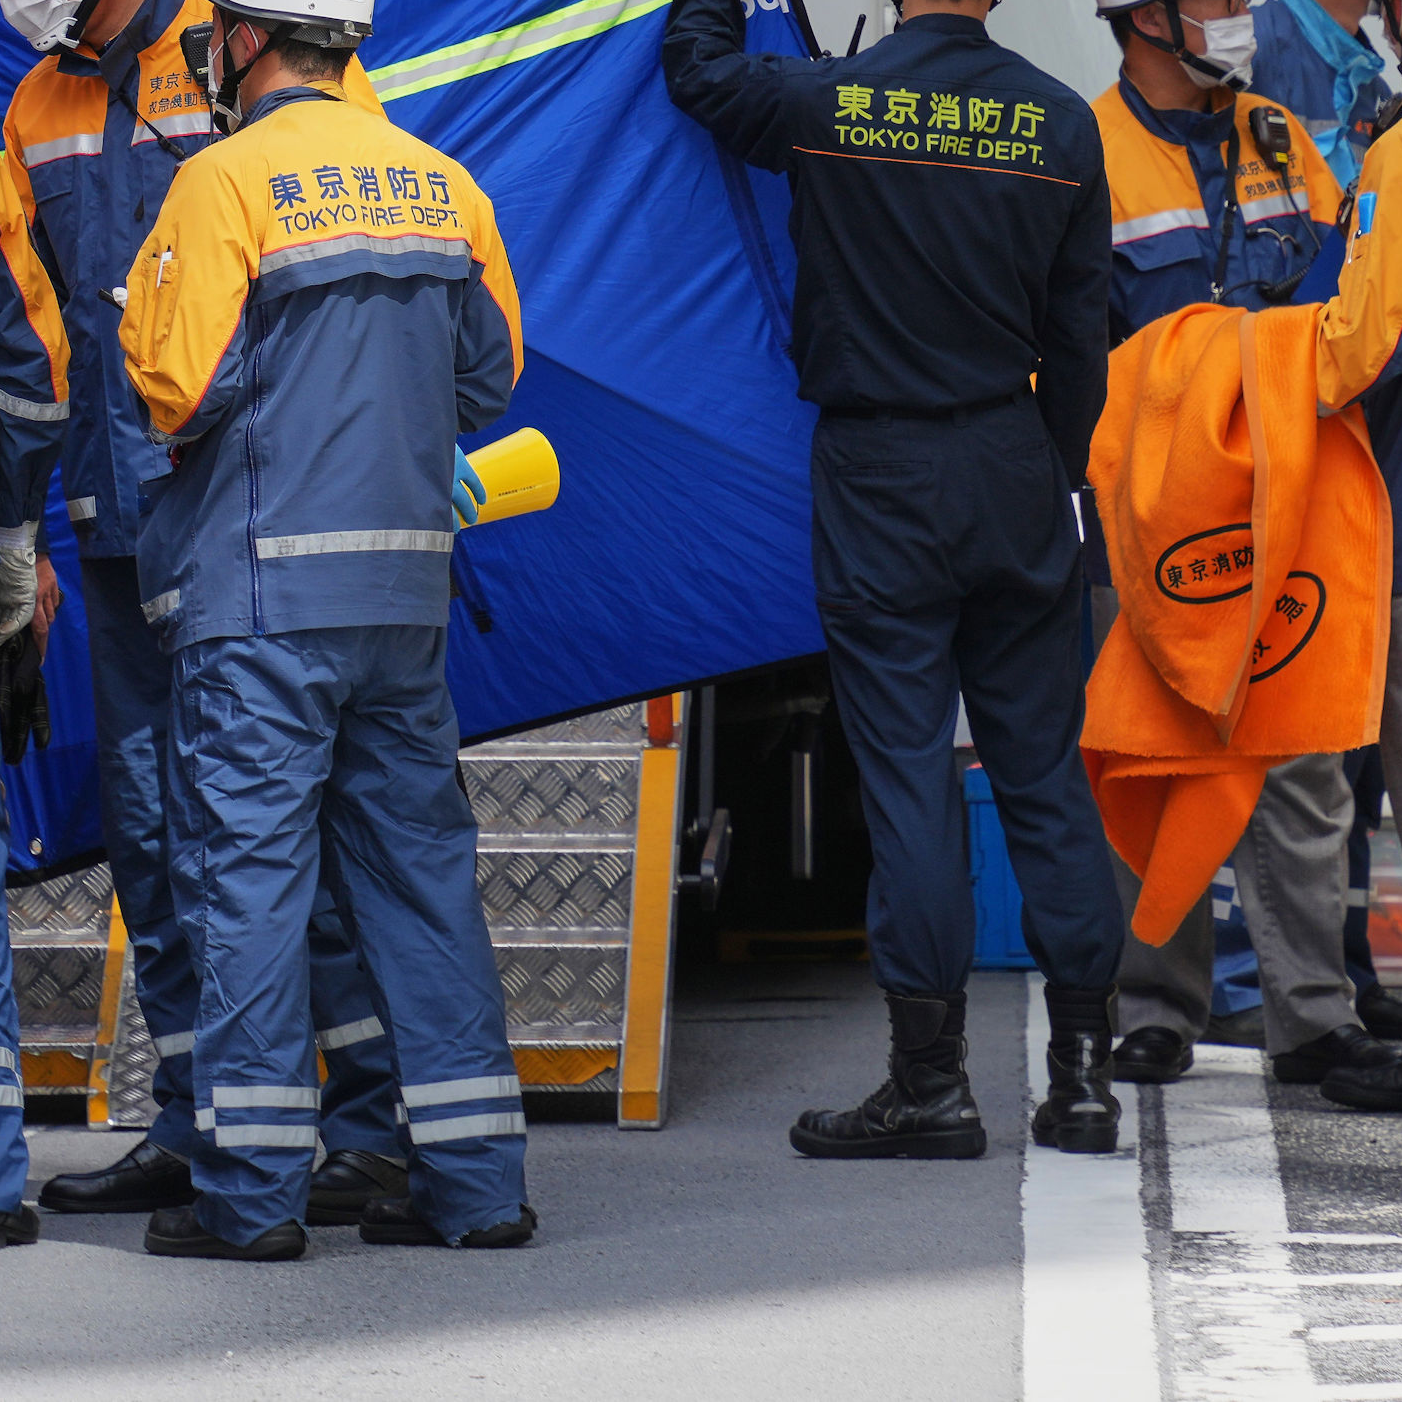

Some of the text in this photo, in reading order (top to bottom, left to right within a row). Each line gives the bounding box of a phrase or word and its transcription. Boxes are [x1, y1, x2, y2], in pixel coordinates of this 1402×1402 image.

[834, 83, 1046, 138] 東京消防庁
[834, 125, 1045, 166] TOKYO FIRE DEPT.
[268, 164, 450, 211] 東京消防庁
[278, 203, 464, 234] TOKYO FIRE DEPT.
